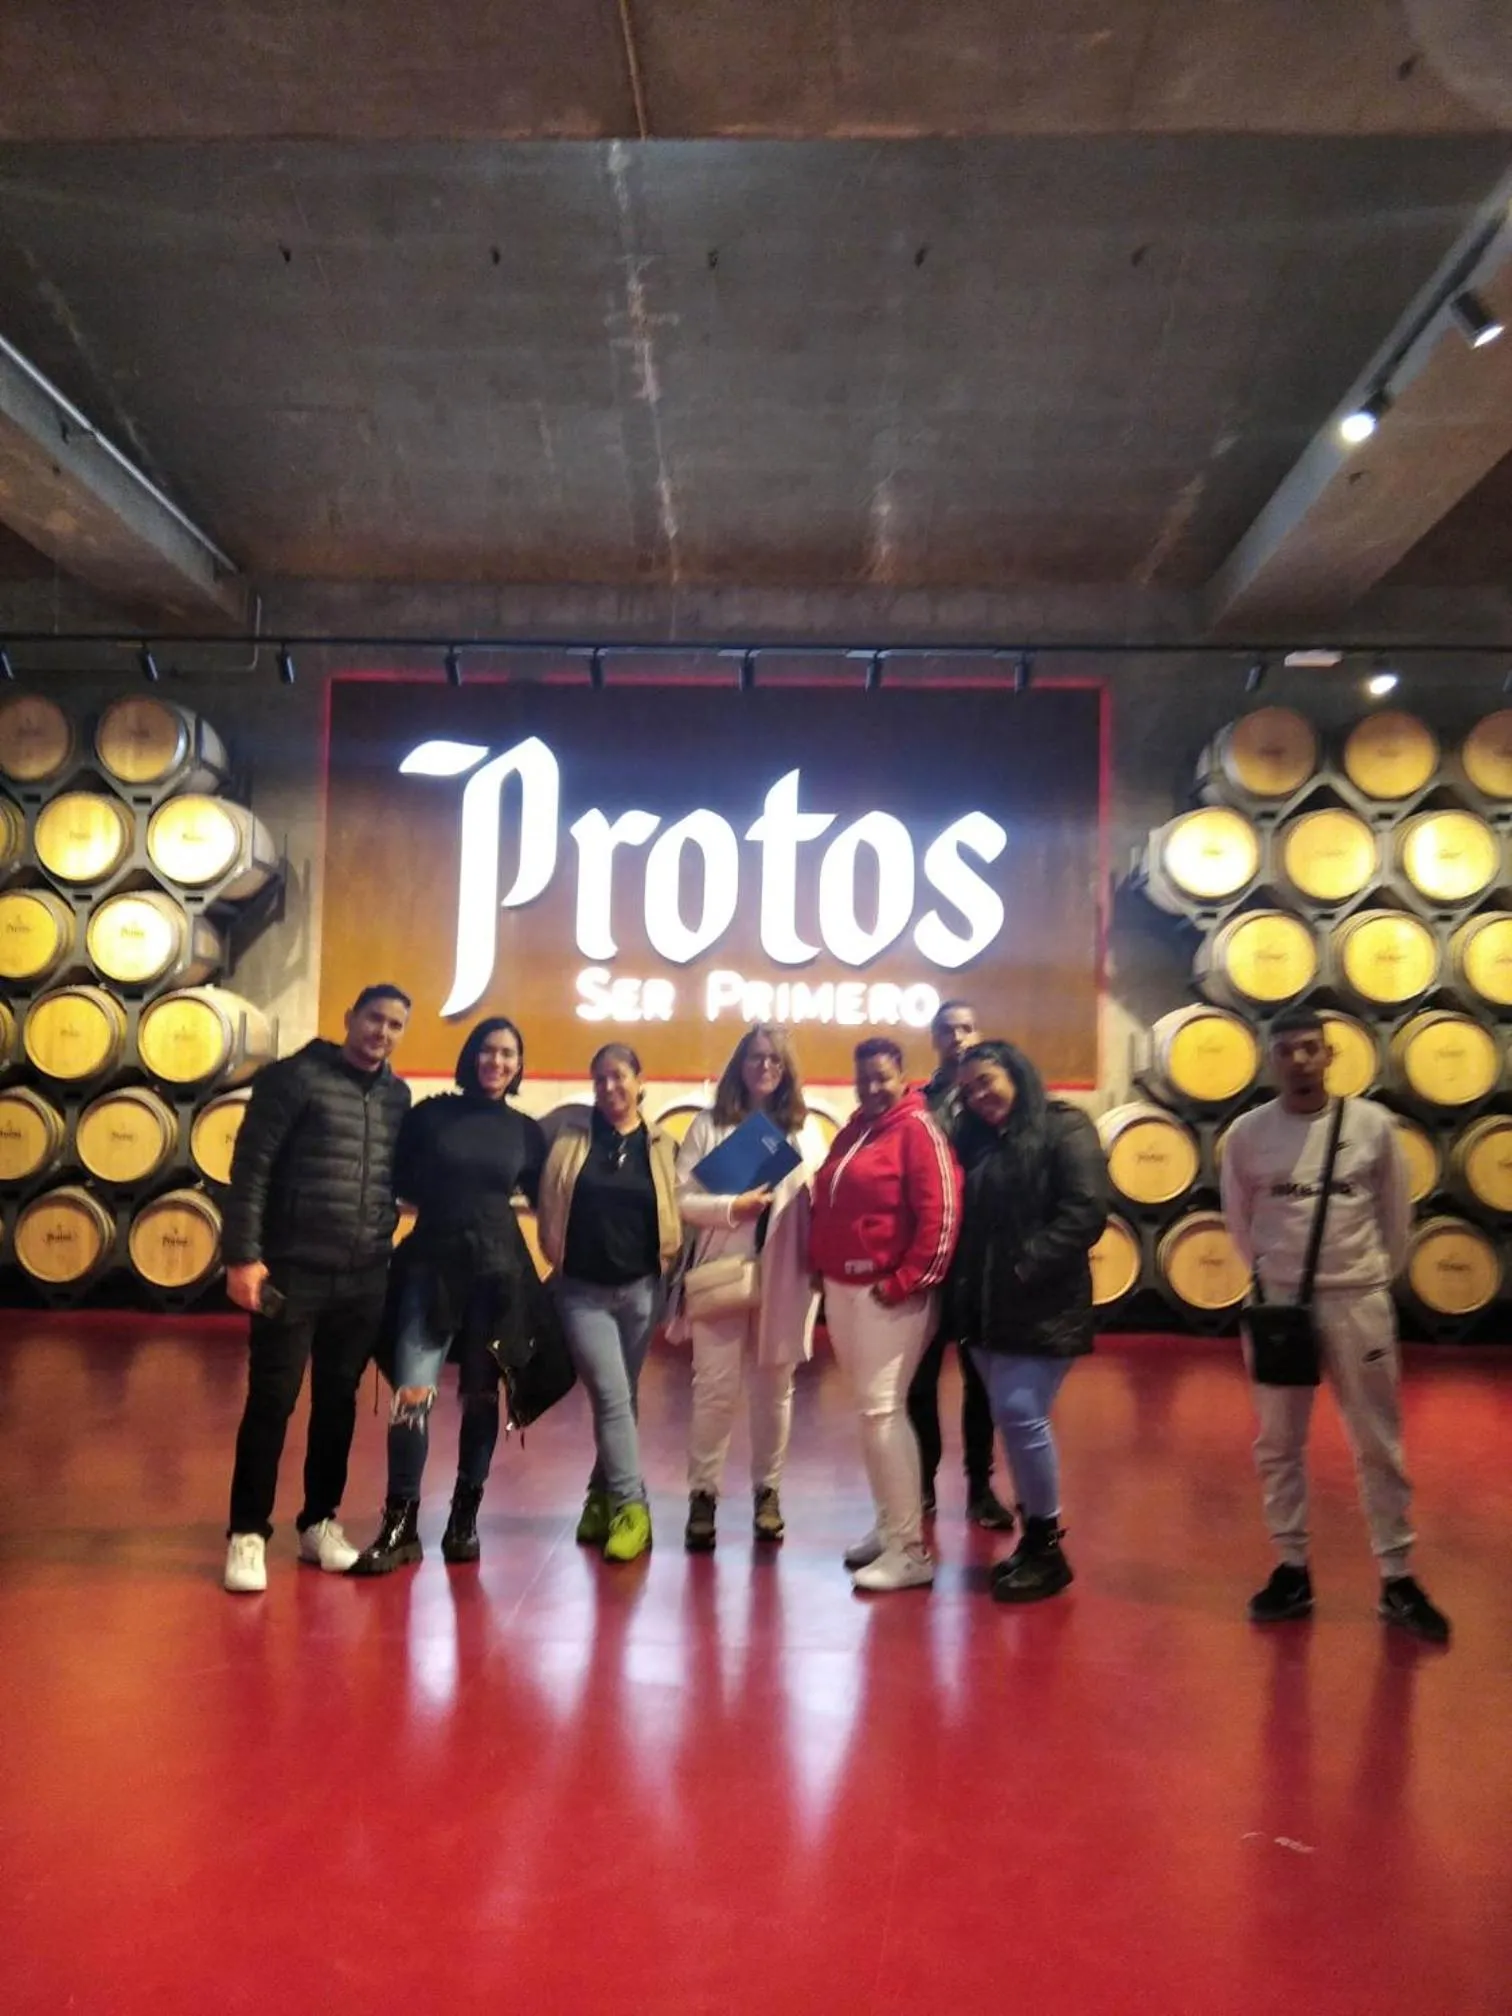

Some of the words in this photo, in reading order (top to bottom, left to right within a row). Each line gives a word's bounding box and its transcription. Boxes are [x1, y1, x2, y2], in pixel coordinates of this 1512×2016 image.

[399, 736, 1007, 1017] Protos
[576, 967, 675, 1021] SER
[706, 970, 940, 1026] PRIMERO
